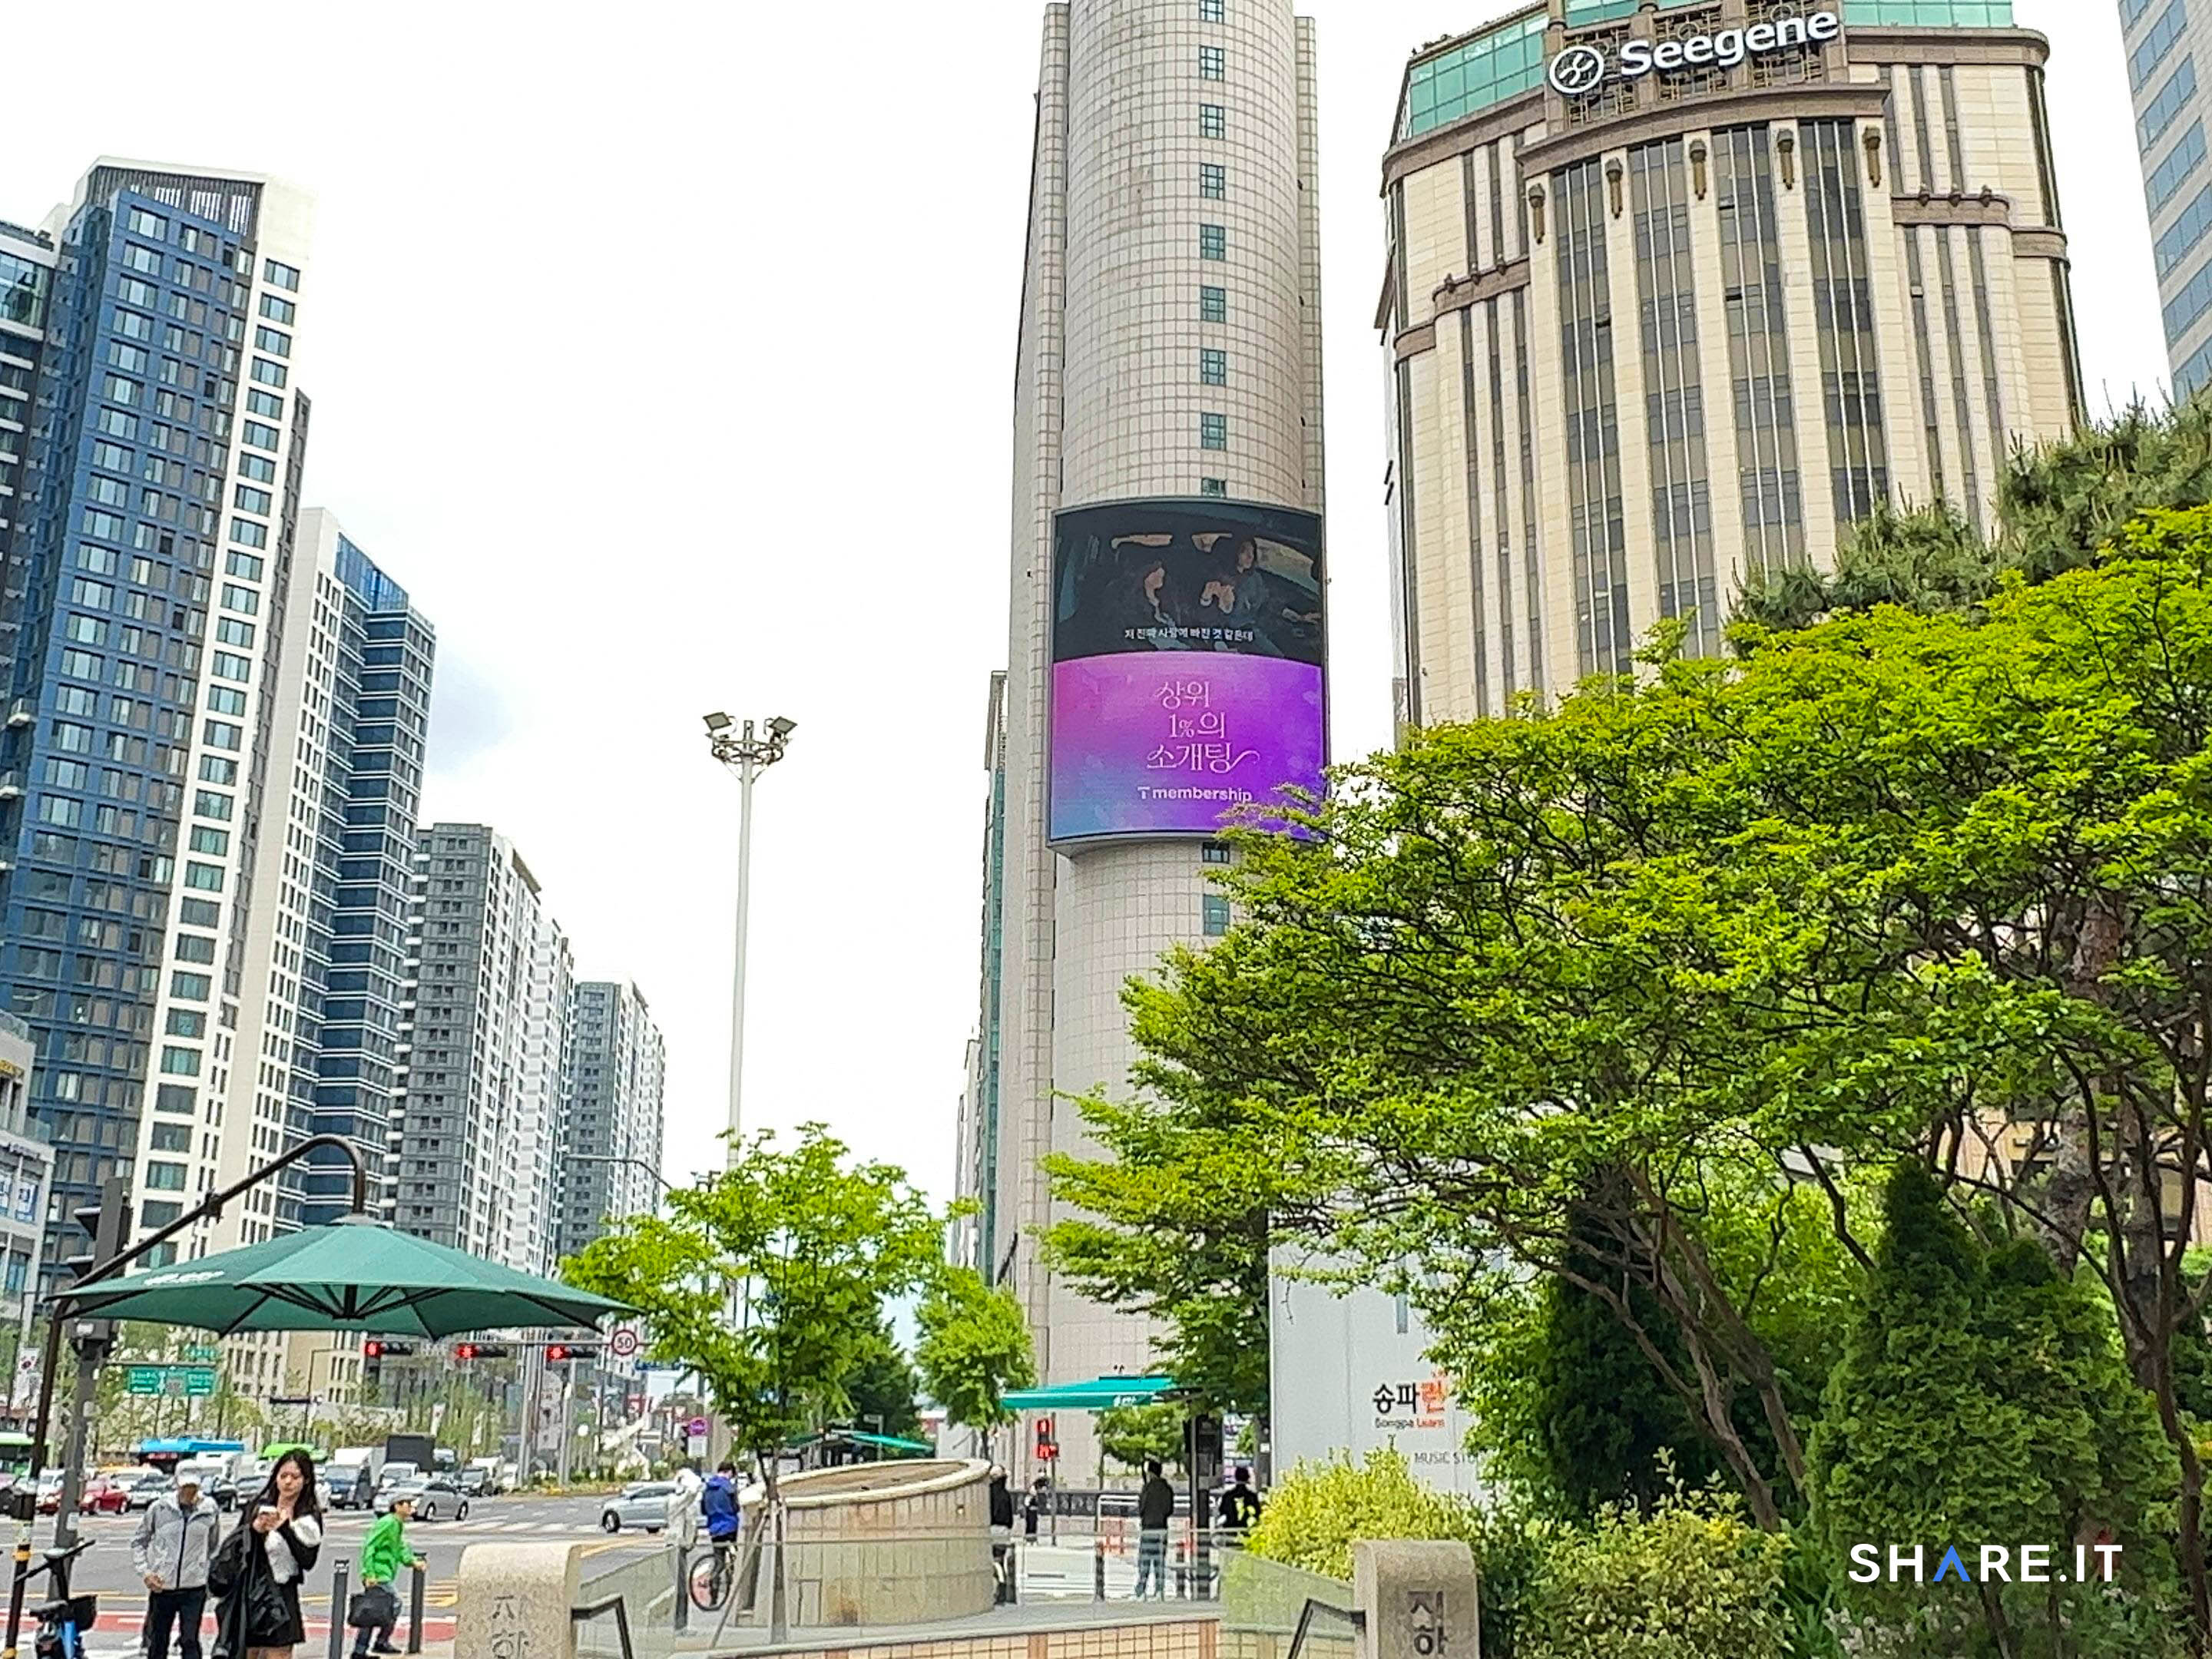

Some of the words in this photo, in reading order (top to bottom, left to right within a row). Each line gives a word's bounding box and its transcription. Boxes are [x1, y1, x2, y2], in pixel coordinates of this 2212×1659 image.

[1620, 11, 1839, 76] Seegene
[1190, 628, 1210, 640] 빠진
[1224, 628, 1253, 641] 같은데
[1154, 680, 1210, 710] 상위
[1169, 711, 1226, 739] 1%의
[1146, 742, 1260, 774] 소개팅
[1152, 786, 1253, 803] membership
[617, 1336, 633, 1349] 50
[1414, 1451, 1450, 1464] MUSIC
[1406, 1590, 1449, 1656] 지하
